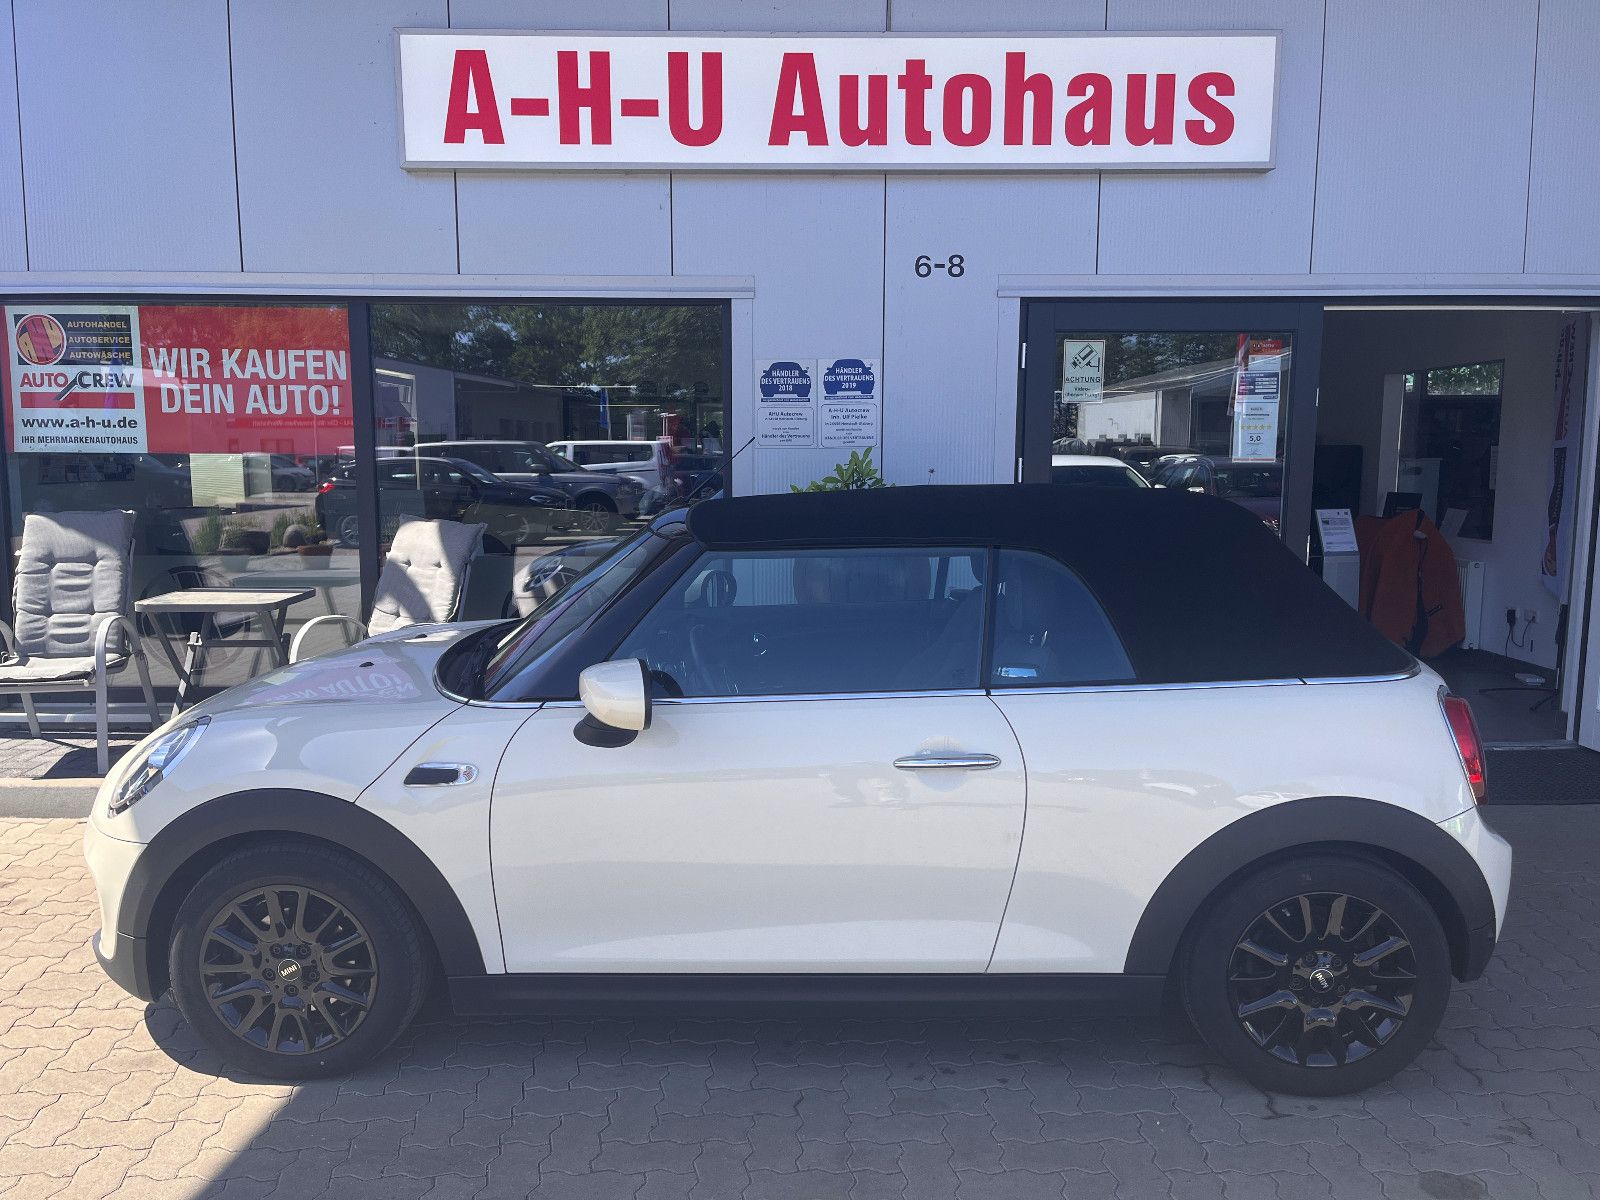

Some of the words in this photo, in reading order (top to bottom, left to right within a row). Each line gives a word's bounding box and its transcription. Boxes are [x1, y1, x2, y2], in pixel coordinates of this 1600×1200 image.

[443, 49, 723, 147] A-H-U
[768, 50, 1237, 147] Autohaus
[914, 254, 966, 279] 6-8
[67, 320, 127, 329] AUTOHANDEL
[68, 336, 131, 344] AUTOSERVICE
[69, 350, 131, 359] AUTOWÄSCHE
[148, 346, 211, 380] WIR
[224, 348, 348, 381] KAUFEN
[771, 369, 799, 377] HÄNDLER
[835, 366, 863, 374] HÄNDLER
[761, 377, 773, 385] DES
[773, 377, 811, 385] VERTRAUENS
[837, 374, 874, 382] VERTRAUENS
[160, 383, 235, 415] DEIN
[246, 385, 340, 416] AUTO!
[21, 415, 139, 429] www.a-h-u.de
[21, 435, 35, 444] IHR
[37, 436, 139, 445] MEHRMARKENAUTOHAUS
[280, 964, 297, 976] MINI
[1315, 973, 1328, 988] MINI
